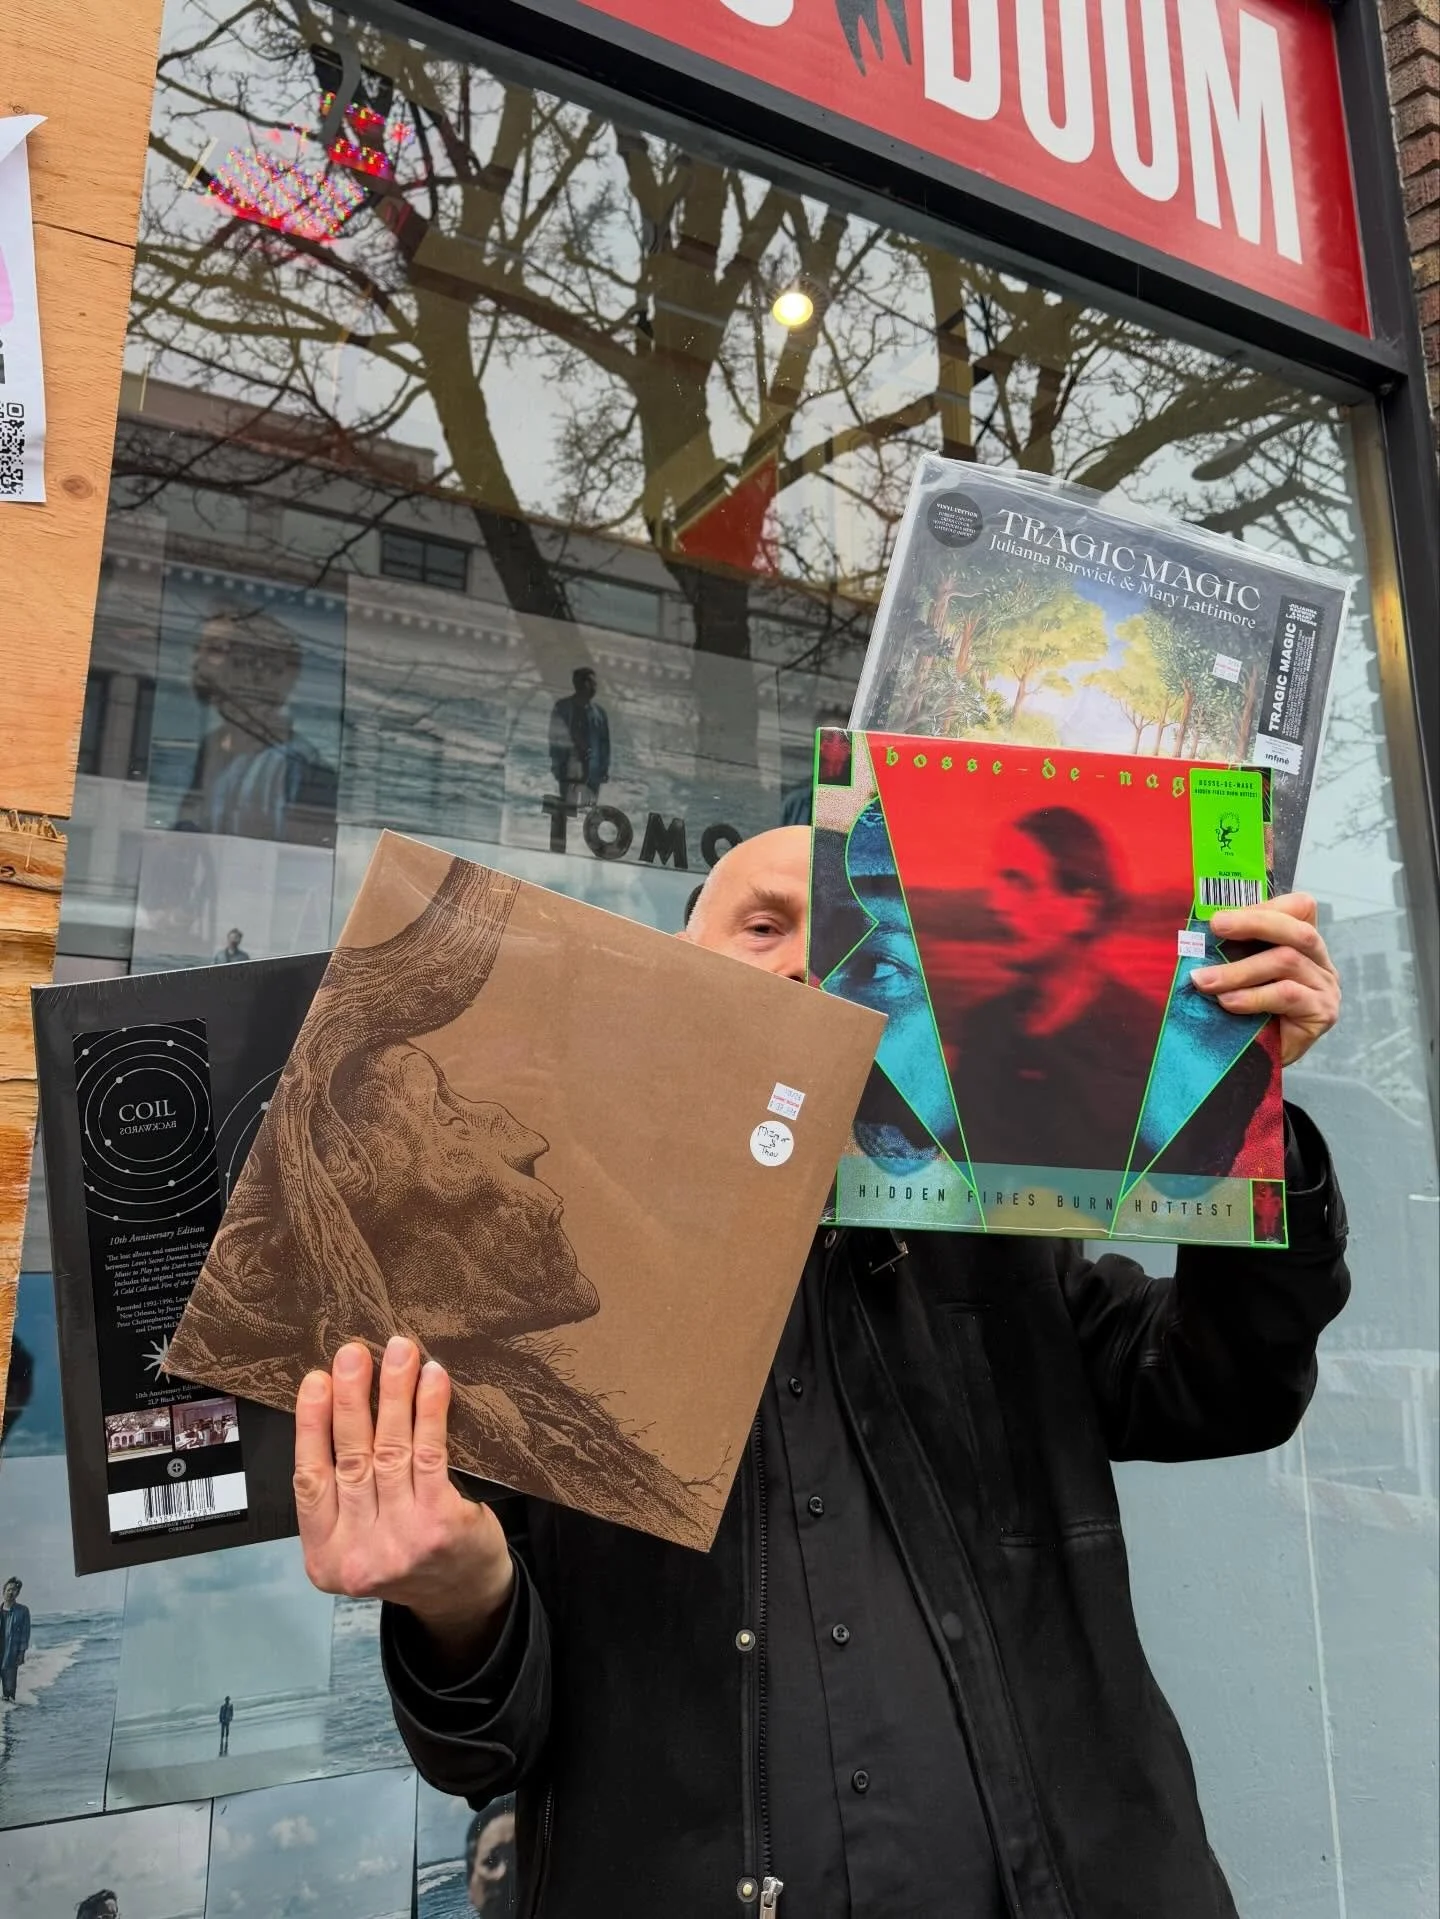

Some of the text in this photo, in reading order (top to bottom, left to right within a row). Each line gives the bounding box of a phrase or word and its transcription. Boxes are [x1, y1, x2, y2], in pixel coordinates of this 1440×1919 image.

[989, 534, 1257, 630] Julianna Barwick & Mary Lattimore
[998, 508, 1136, 572] TRAGIC
[1142, 553, 1261, 612] MAGIC
[1268, 674, 1288, 733] TRAGIC
[1279, 622, 1297, 673] MAGIC
[118, 1099, 177, 1122] COIL
[858, 1183, 1235, 1218] HIDDEN FIRES BURN HOTTEST
